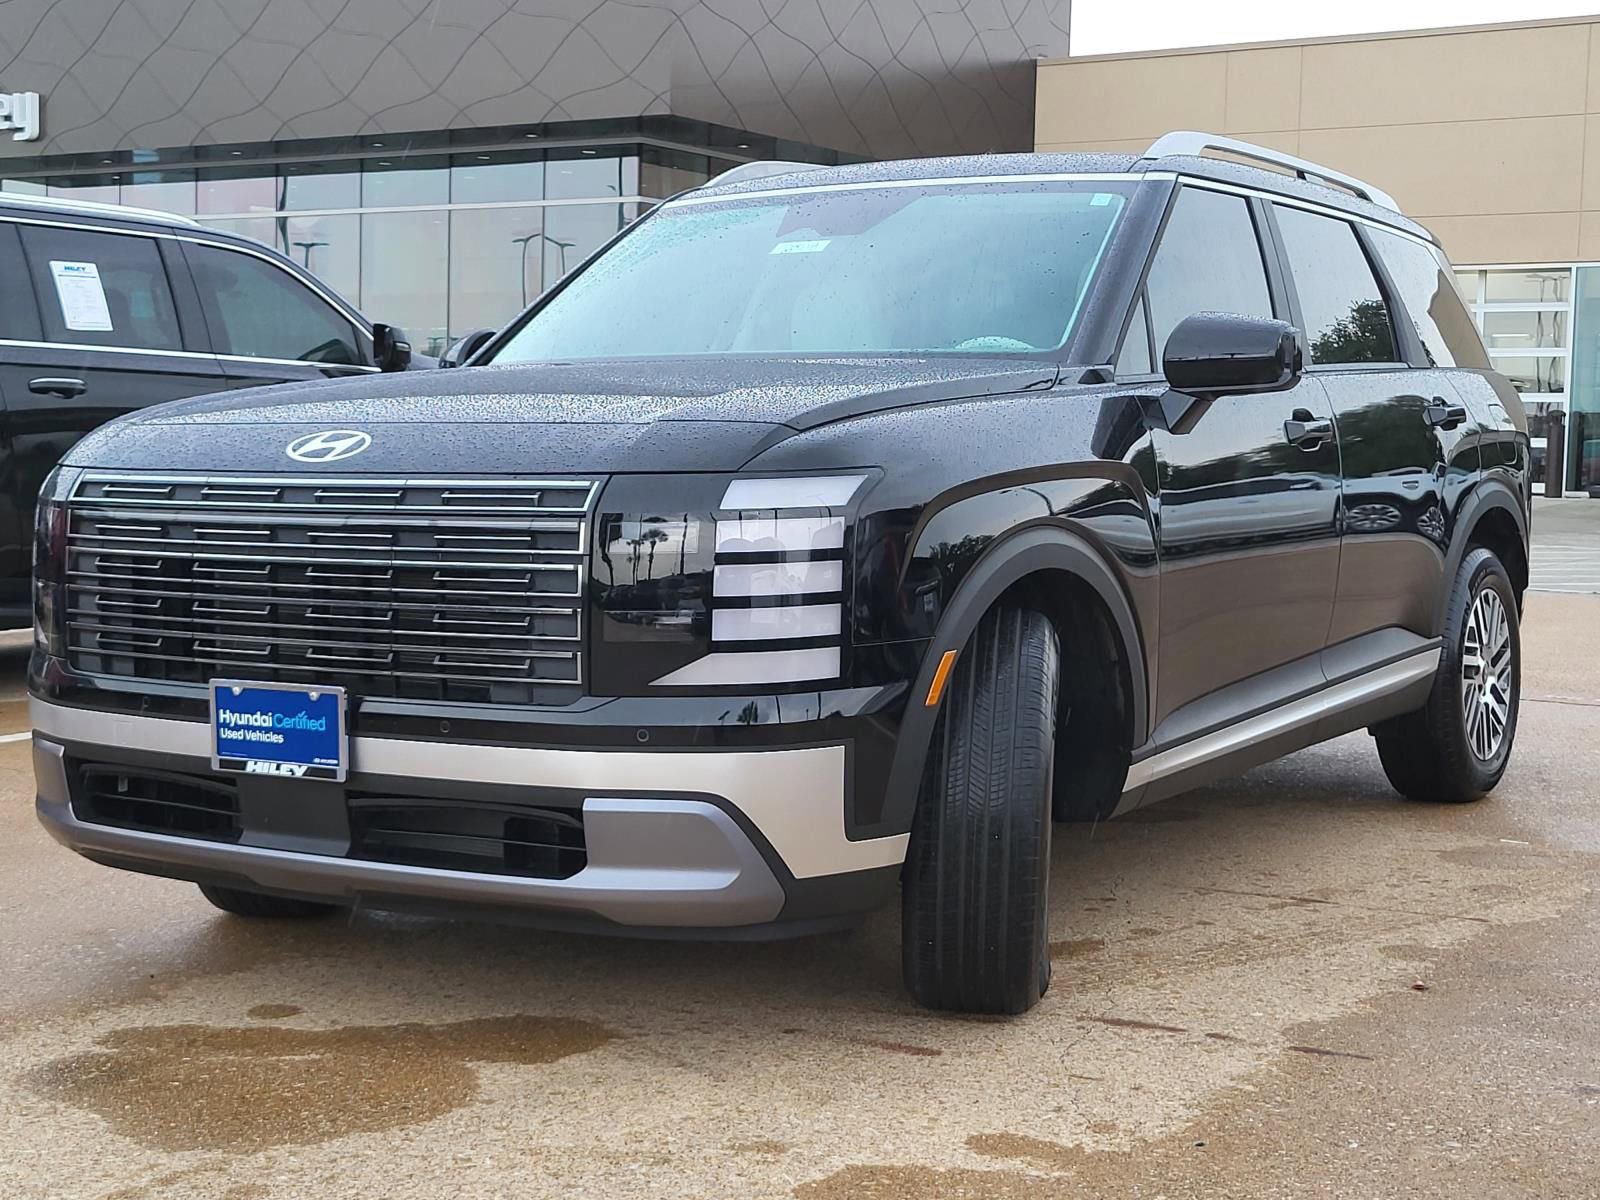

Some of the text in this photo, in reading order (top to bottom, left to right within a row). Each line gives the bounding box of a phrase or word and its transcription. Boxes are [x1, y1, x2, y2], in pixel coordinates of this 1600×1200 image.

[219, 708, 326, 731] Hyundai Certified
[220, 727, 284, 743] Used Vehicles
[245, 760, 308, 777] HILEY
